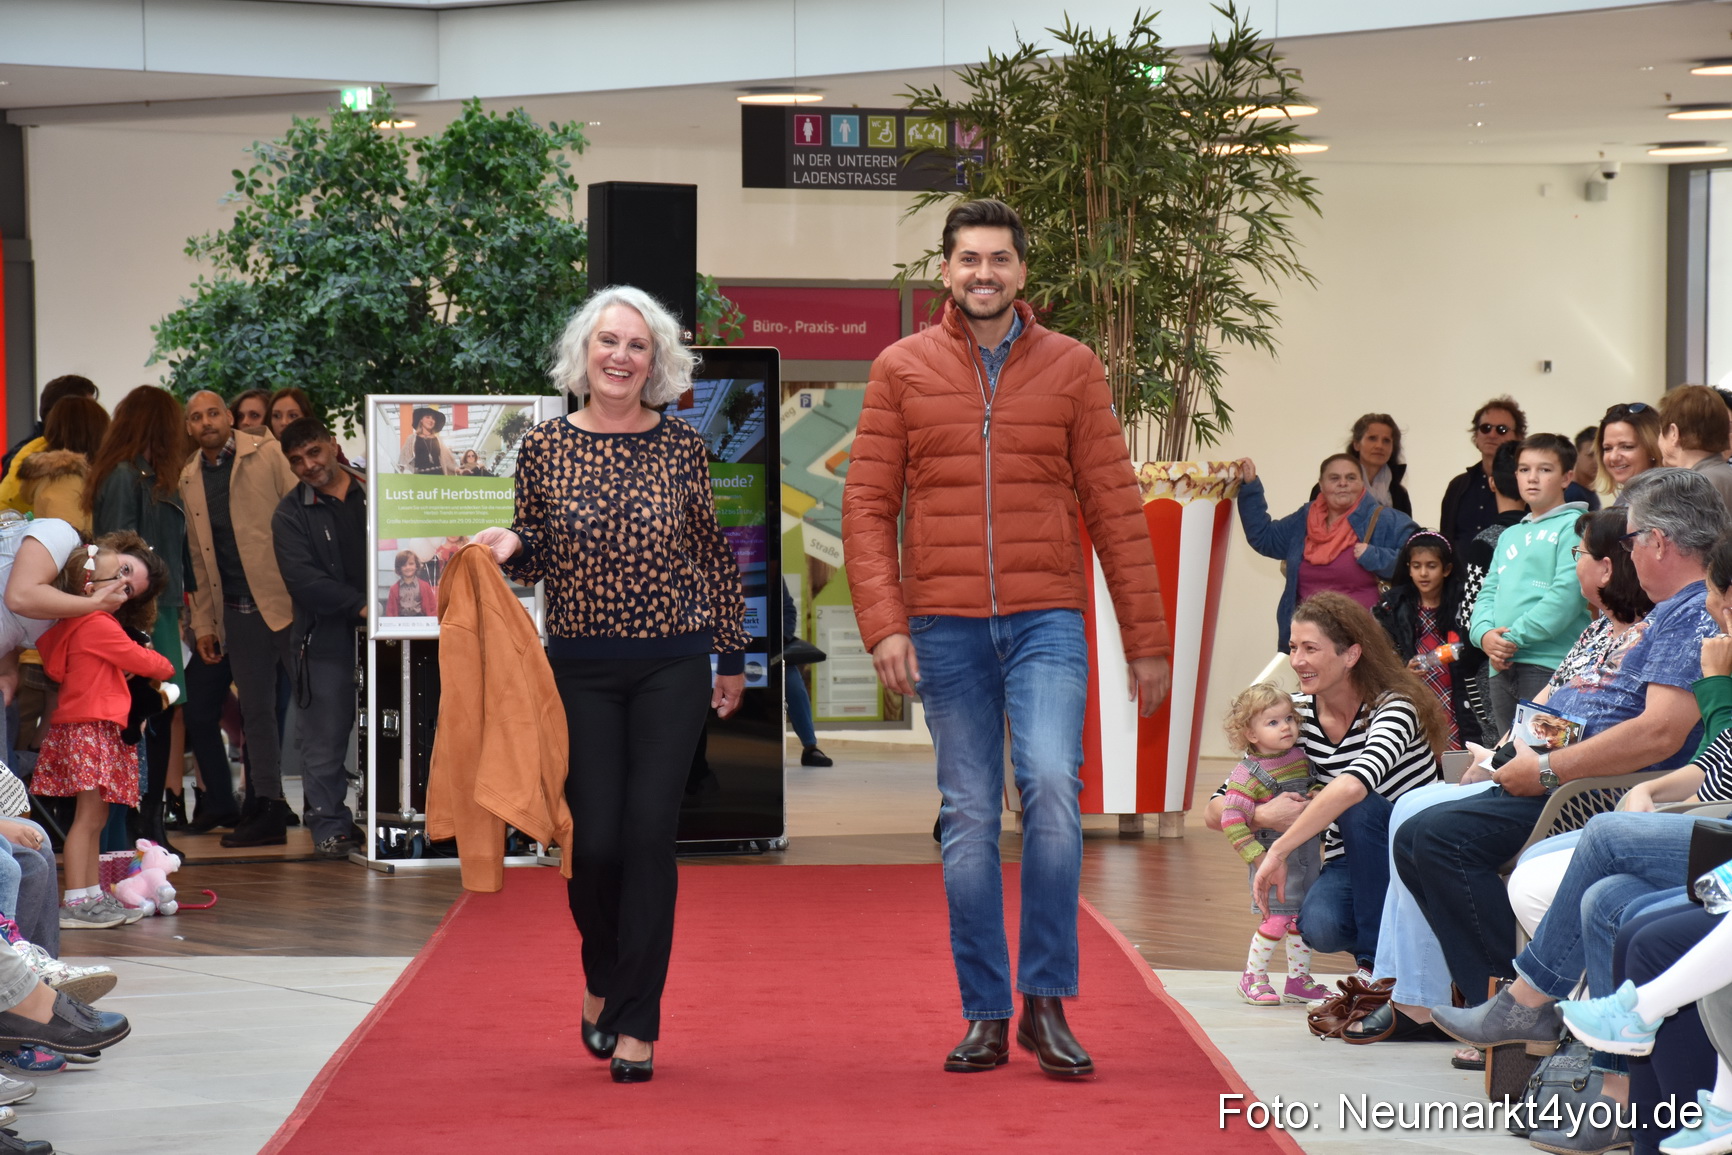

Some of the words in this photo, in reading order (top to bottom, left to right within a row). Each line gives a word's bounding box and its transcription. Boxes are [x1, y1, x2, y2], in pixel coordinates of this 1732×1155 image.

[871, 120, 882, 128] WC
[793, 153, 805, 166] IN
[809, 153, 832, 167] DER
[837, 154, 898, 168] UNTEREN
[793, 171, 898, 186] LADENSTRASSE
[752, 319, 793, 335] Büro-,
[795, 320, 839, 334] Praxis-
[841, 320, 867, 334] und
[385, 488, 415, 500] Lust
[416, 488, 439, 500] auf
[810, 538, 840, 559] Straße
[816, 609, 824, 620] 2
